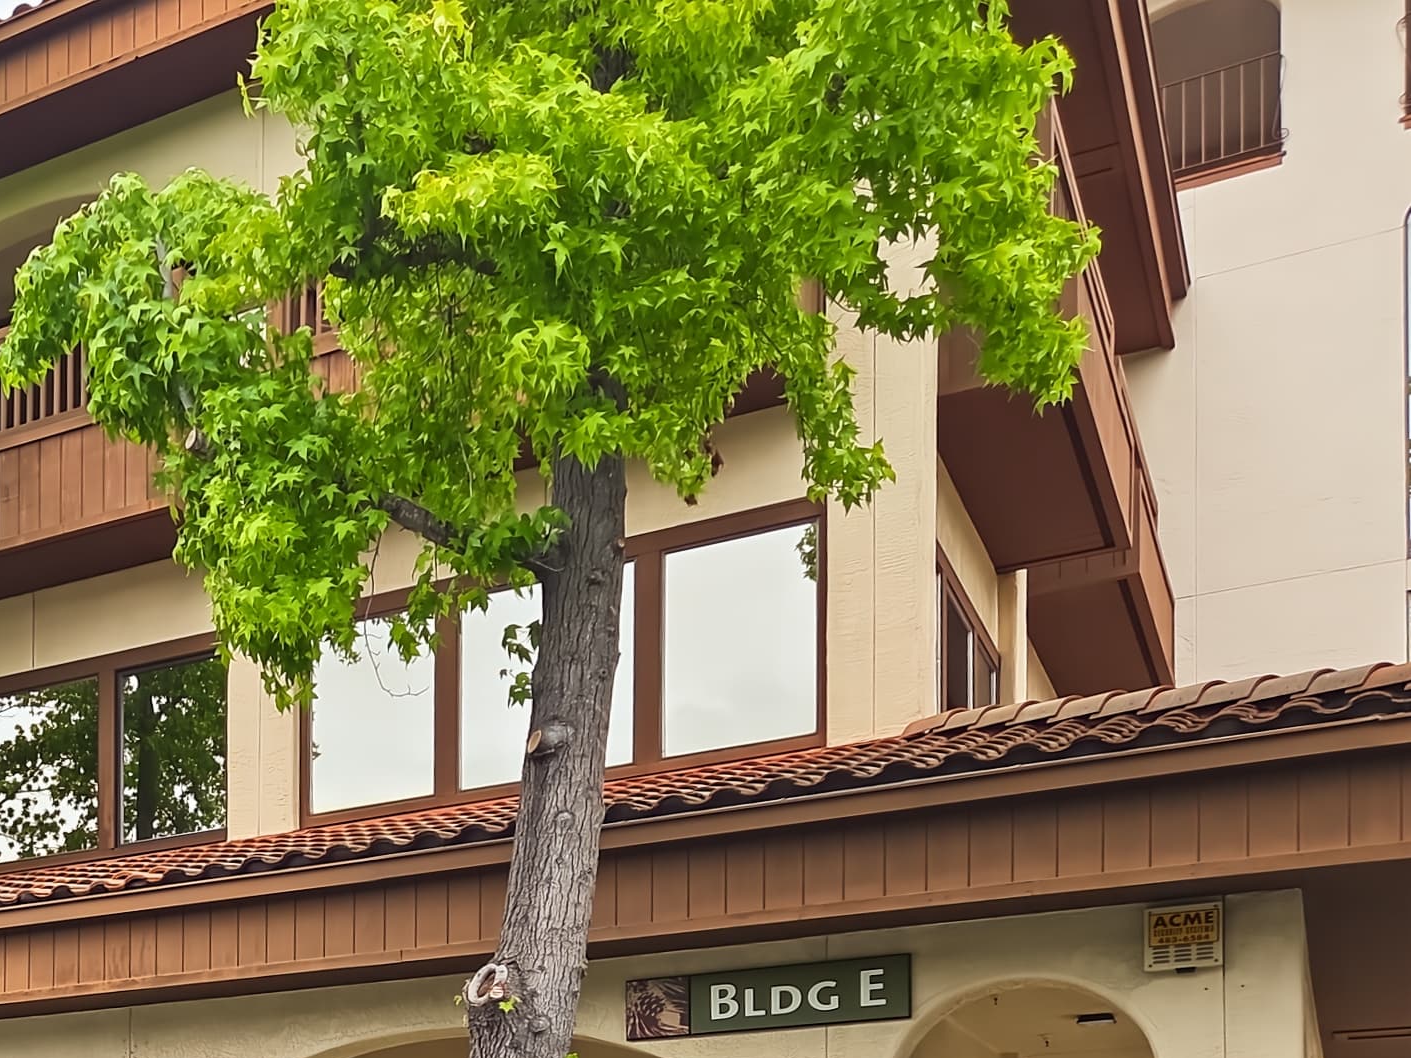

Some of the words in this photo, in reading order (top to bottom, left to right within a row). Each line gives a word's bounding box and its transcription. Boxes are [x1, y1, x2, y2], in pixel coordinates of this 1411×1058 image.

[1153, 911, 1214, 928] ACME
[710, 981, 839, 1020] BLDG
[860, 968, 887, 1007] E
